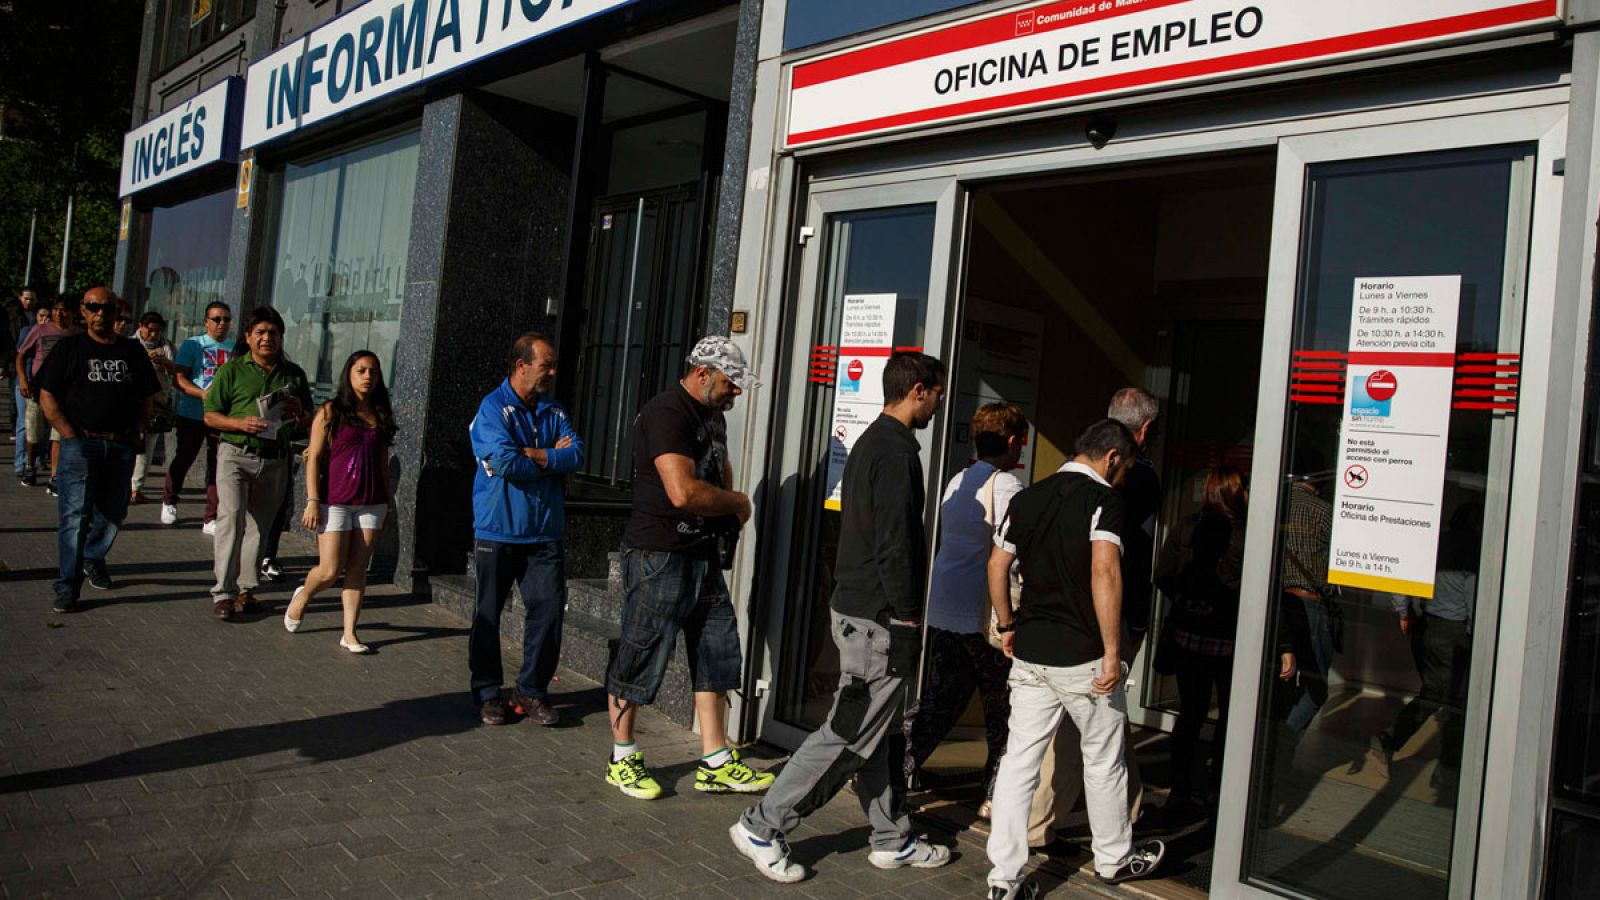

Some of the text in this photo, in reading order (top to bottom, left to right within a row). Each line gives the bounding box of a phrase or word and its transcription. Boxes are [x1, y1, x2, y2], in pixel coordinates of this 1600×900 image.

[1036, 3, 1096, 25] Comunidad
[1098, 1, 1113, 11] de
[934, 6, 1264, 95] OFICINA DE EMPLEO
[131, 101, 206, 185] INGLÉS
[1360, 282, 1394, 290] Horario
[1359, 292, 1385, 300] Lunes
[1395, 291, 1429, 299] Viernes
[1359, 306, 1371, 314] De
[1372, 306, 1379, 314] 9
[1380, 306, 1389, 314] h.
[1400, 306, 1424, 314] 10:30
[1359, 315, 1394, 324] Trámites
[1356, 329, 1369, 338] De
[1371, 329, 1393, 337] 10:30
[1412, 330, 1436, 338] 14:30
[1355, 339, 1436, 348] Atención previa cita
[1346, 447, 1381, 455] permitido
[1341, 501, 1375, 512] Horario
[1340, 510, 1432, 528] Oficina de Prestaciones
[1336, 548, 1361, 559] Lunes
[1369, 552, 1400, 564] Viernes
[1335, 558, 1348, 567] De
[1348, 560, 1354, 568] 9
[1373, 563, 1383, 571] 14
